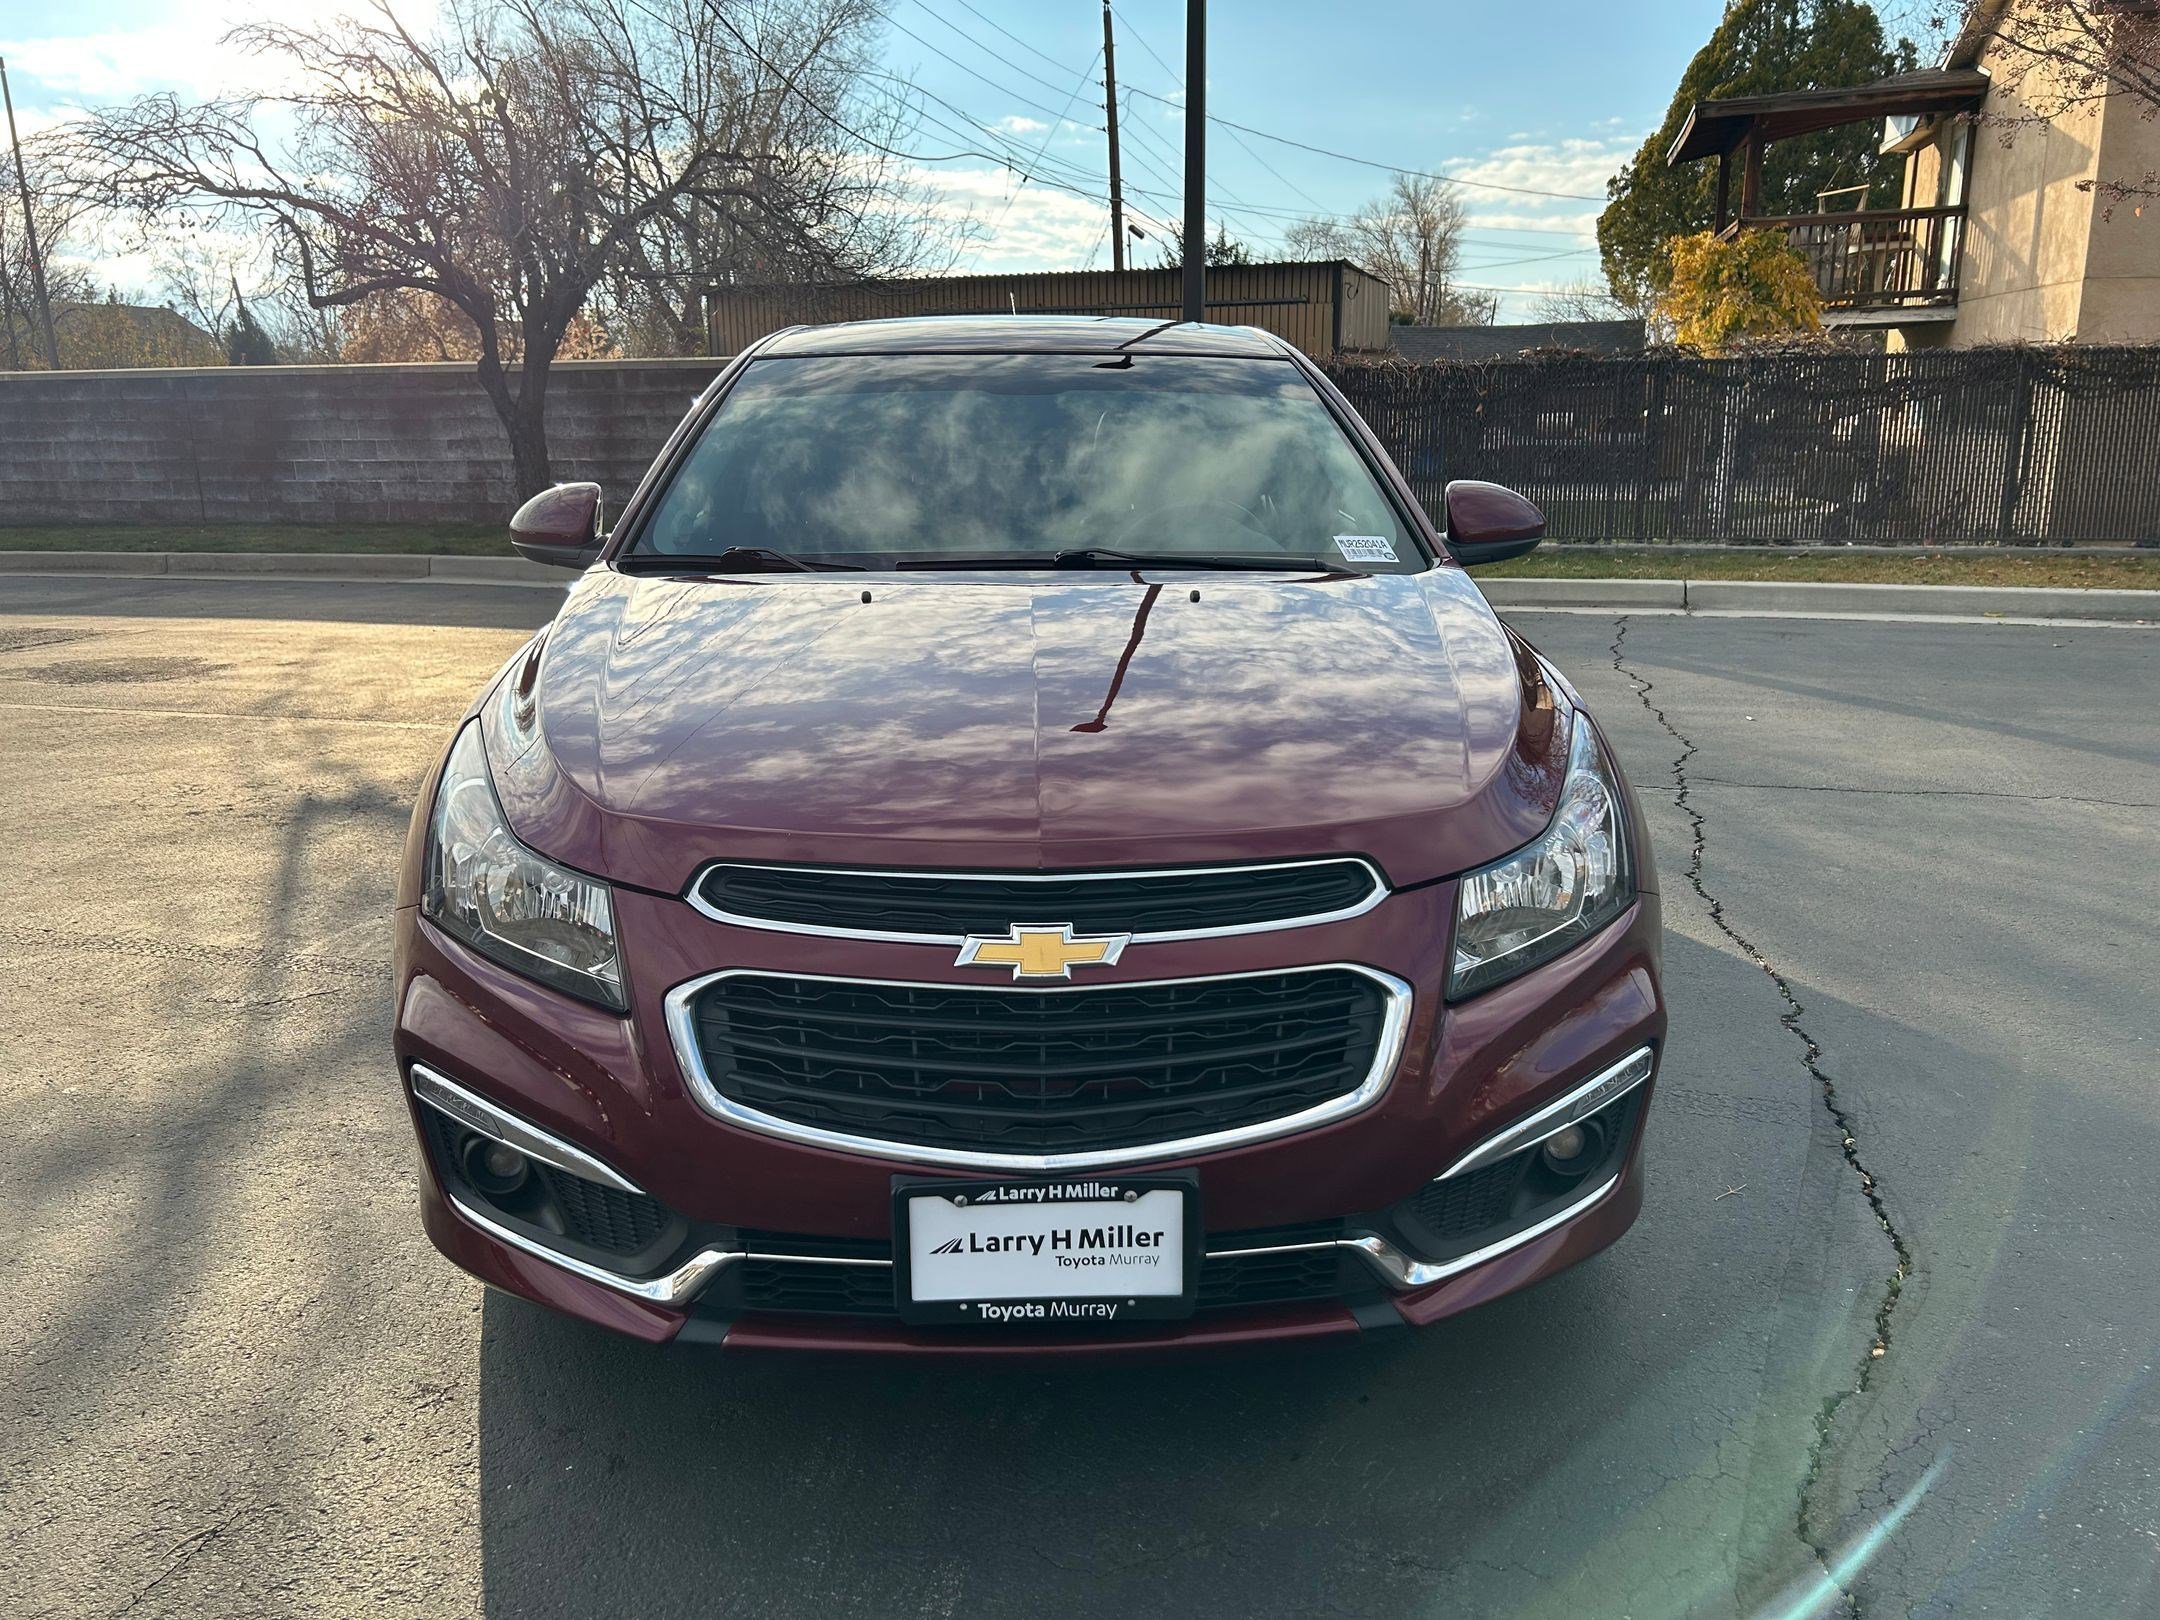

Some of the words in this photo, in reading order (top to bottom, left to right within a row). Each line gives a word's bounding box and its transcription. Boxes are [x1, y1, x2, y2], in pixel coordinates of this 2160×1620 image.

[999, 1184, 1045, 1202] Larry
[1048, 1185, 1063, 1199] H
[1066, 1182, 1118, 1199] Miller
[969, 1232, 1045, 1255] Larry
[1052, 1229, 1072, 1250] H
[1079, 1225, 1165, 1249] Miller
[1055, 1255, 1105, 1269] Toyota
[1109, 1253, 1160, 1267] Murray
[978, 1302, 1045, 1322] Toyota
[1050, 1301, 1117, 1320] Murray
